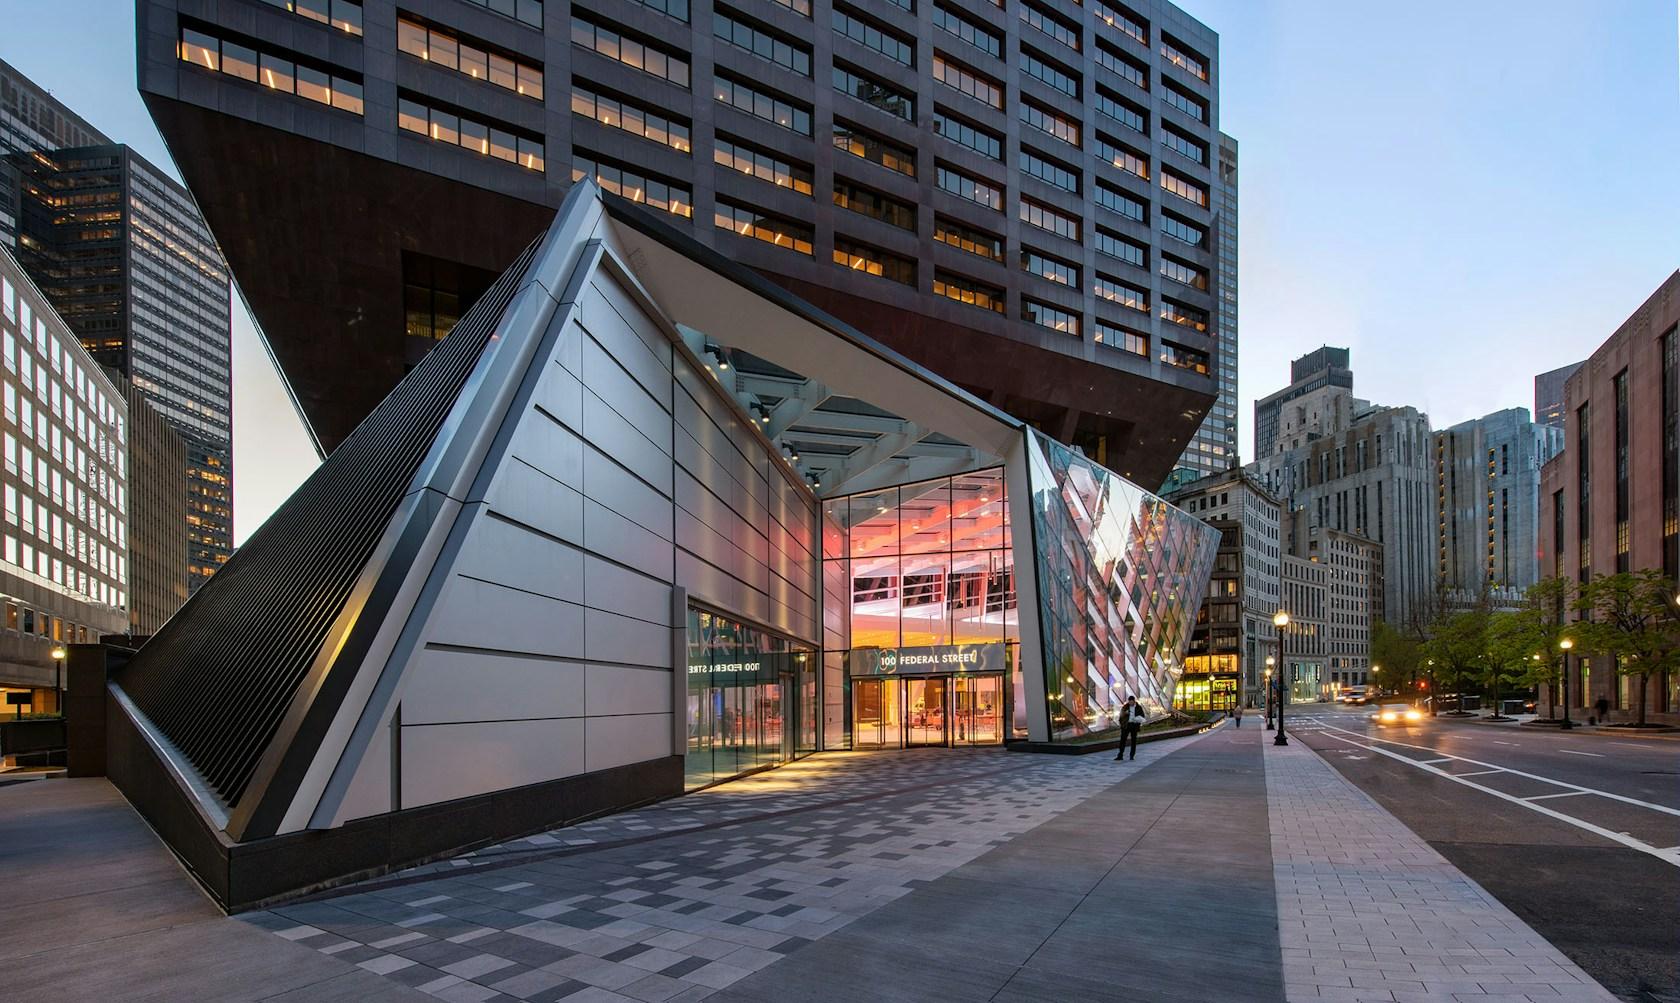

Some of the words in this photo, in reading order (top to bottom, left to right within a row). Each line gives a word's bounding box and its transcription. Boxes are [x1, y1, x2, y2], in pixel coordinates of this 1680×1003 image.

[880, 657, 896, 666] 100
[900, 656, 939, 665] FEDERAL
[942, 654, 974, 663] STREET
